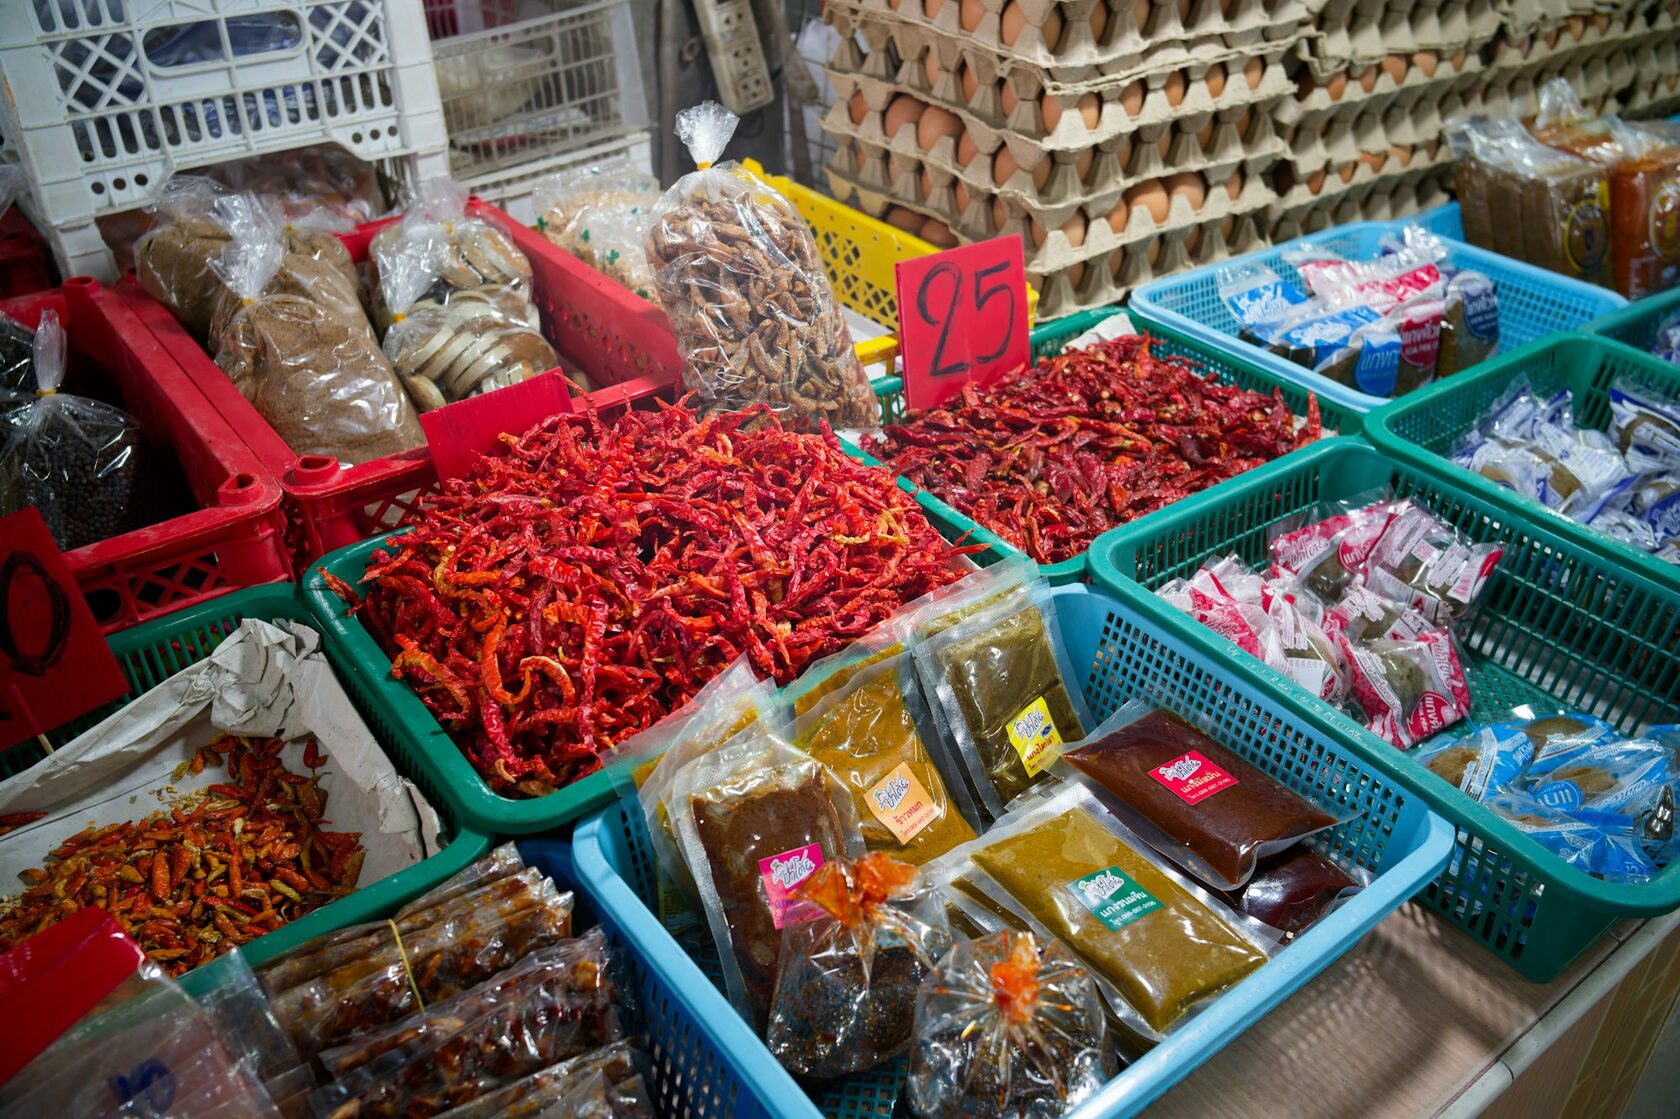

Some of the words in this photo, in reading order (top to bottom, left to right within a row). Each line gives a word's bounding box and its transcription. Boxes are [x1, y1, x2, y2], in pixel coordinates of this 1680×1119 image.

[917, 261, 1015, 377] 25
[893, 801, 924, 825] ข้าวหมก
[1100, 891, 1148, 918] แกงขนมจีน
